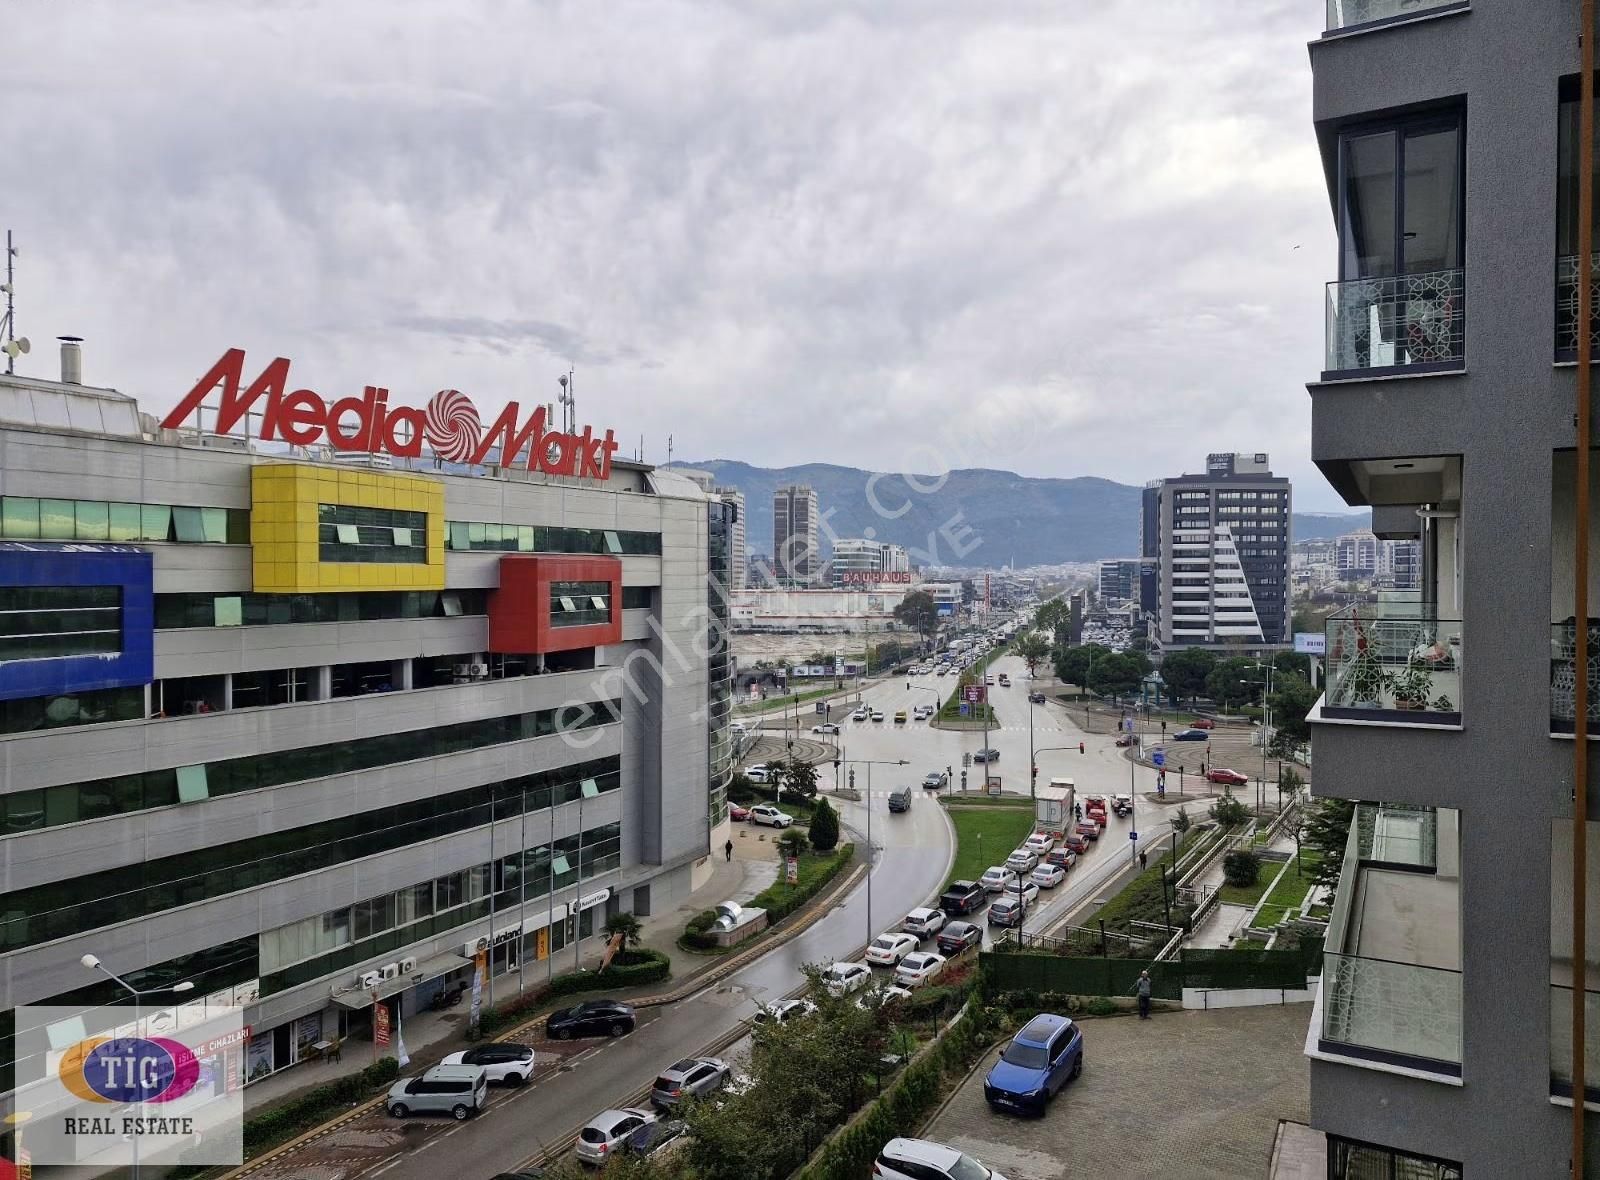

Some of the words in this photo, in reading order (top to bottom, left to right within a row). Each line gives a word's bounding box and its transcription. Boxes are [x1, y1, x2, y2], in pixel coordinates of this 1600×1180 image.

[159, 347, 424, 457] Media
[469, 400, 619, 480] Markt
[843, 572, 910, 583] BAUHAUS
